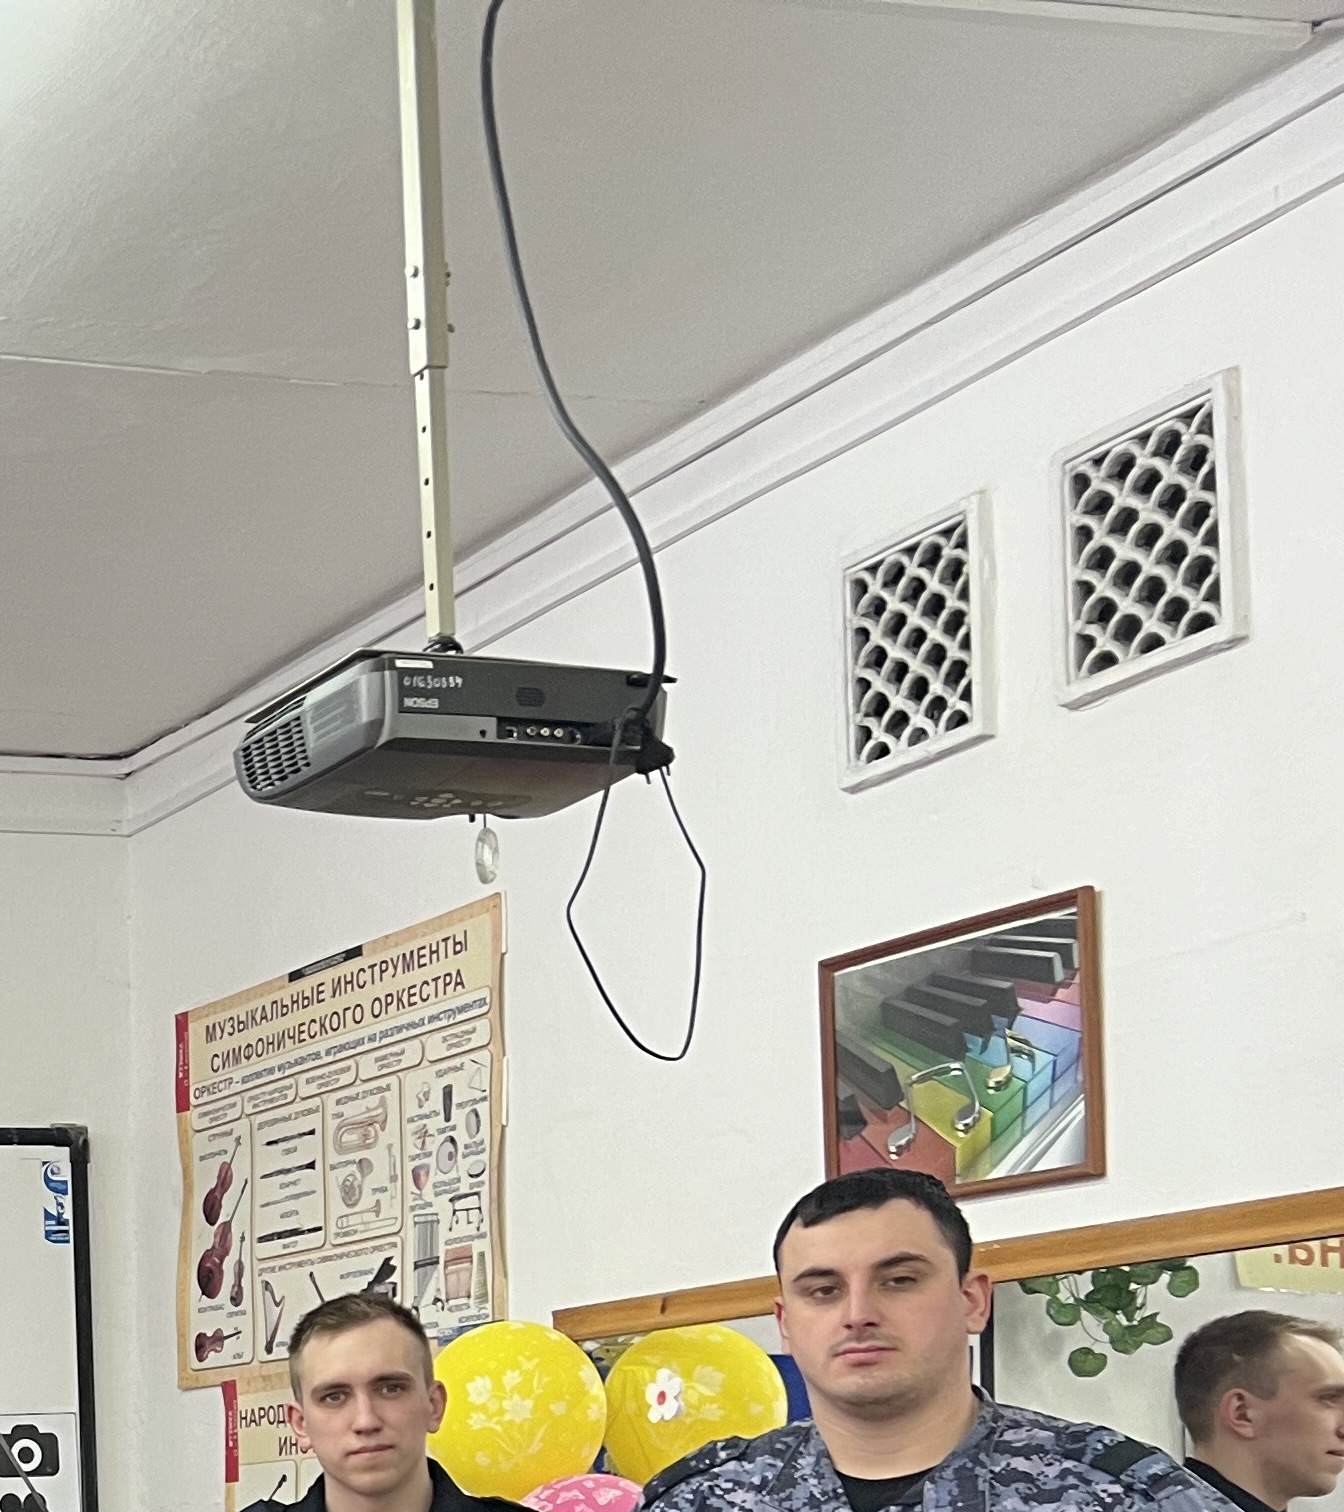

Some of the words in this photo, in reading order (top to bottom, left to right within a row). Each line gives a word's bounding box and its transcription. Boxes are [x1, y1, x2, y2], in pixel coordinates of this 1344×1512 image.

[205, 982, 326, 1045] МУЗЫКАЛЬНЫЕ
[331, 930, 468, 998] ИНСТРУМЕНТЫ
[211, 1003, 363, 1073] СИМФОНИЧЕСКОГО
[372, 968, 465, 1019] ОРКЕСТРА
[193, 1077, 234, 1100] ОРКЕСТР
